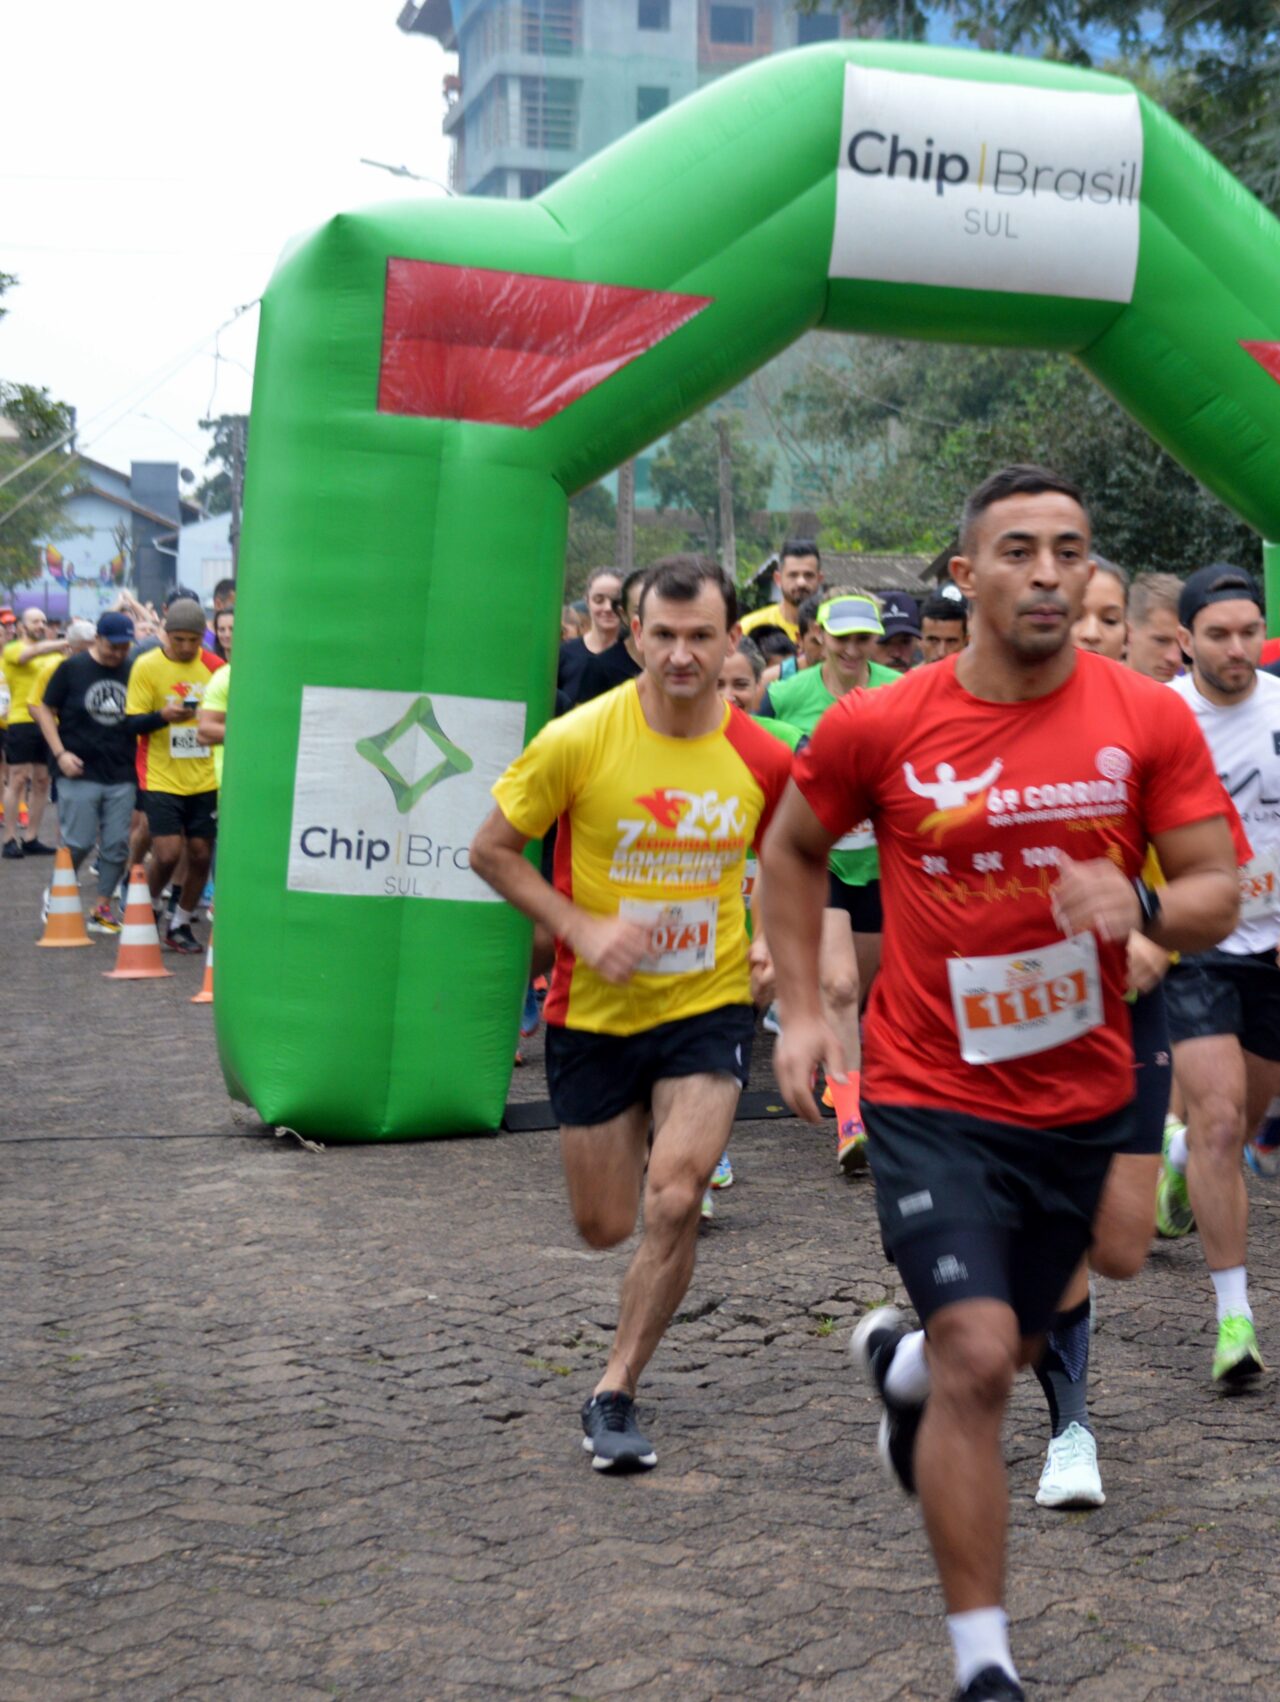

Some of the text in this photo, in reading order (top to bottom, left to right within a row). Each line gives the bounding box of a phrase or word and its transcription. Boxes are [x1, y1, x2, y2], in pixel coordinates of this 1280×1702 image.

[847, 129, 1137, 206] Chip Brasil
[963, 207, 1019, 240] SUL
[1023, 779, 1128, 809] CORRIDA
[299, 826, 471, 871] Chip Bra
[384, 875, 424, 896] SUL
[651, 923, 702, 951] 073
[976, 976, 1080, 1028] 1119
